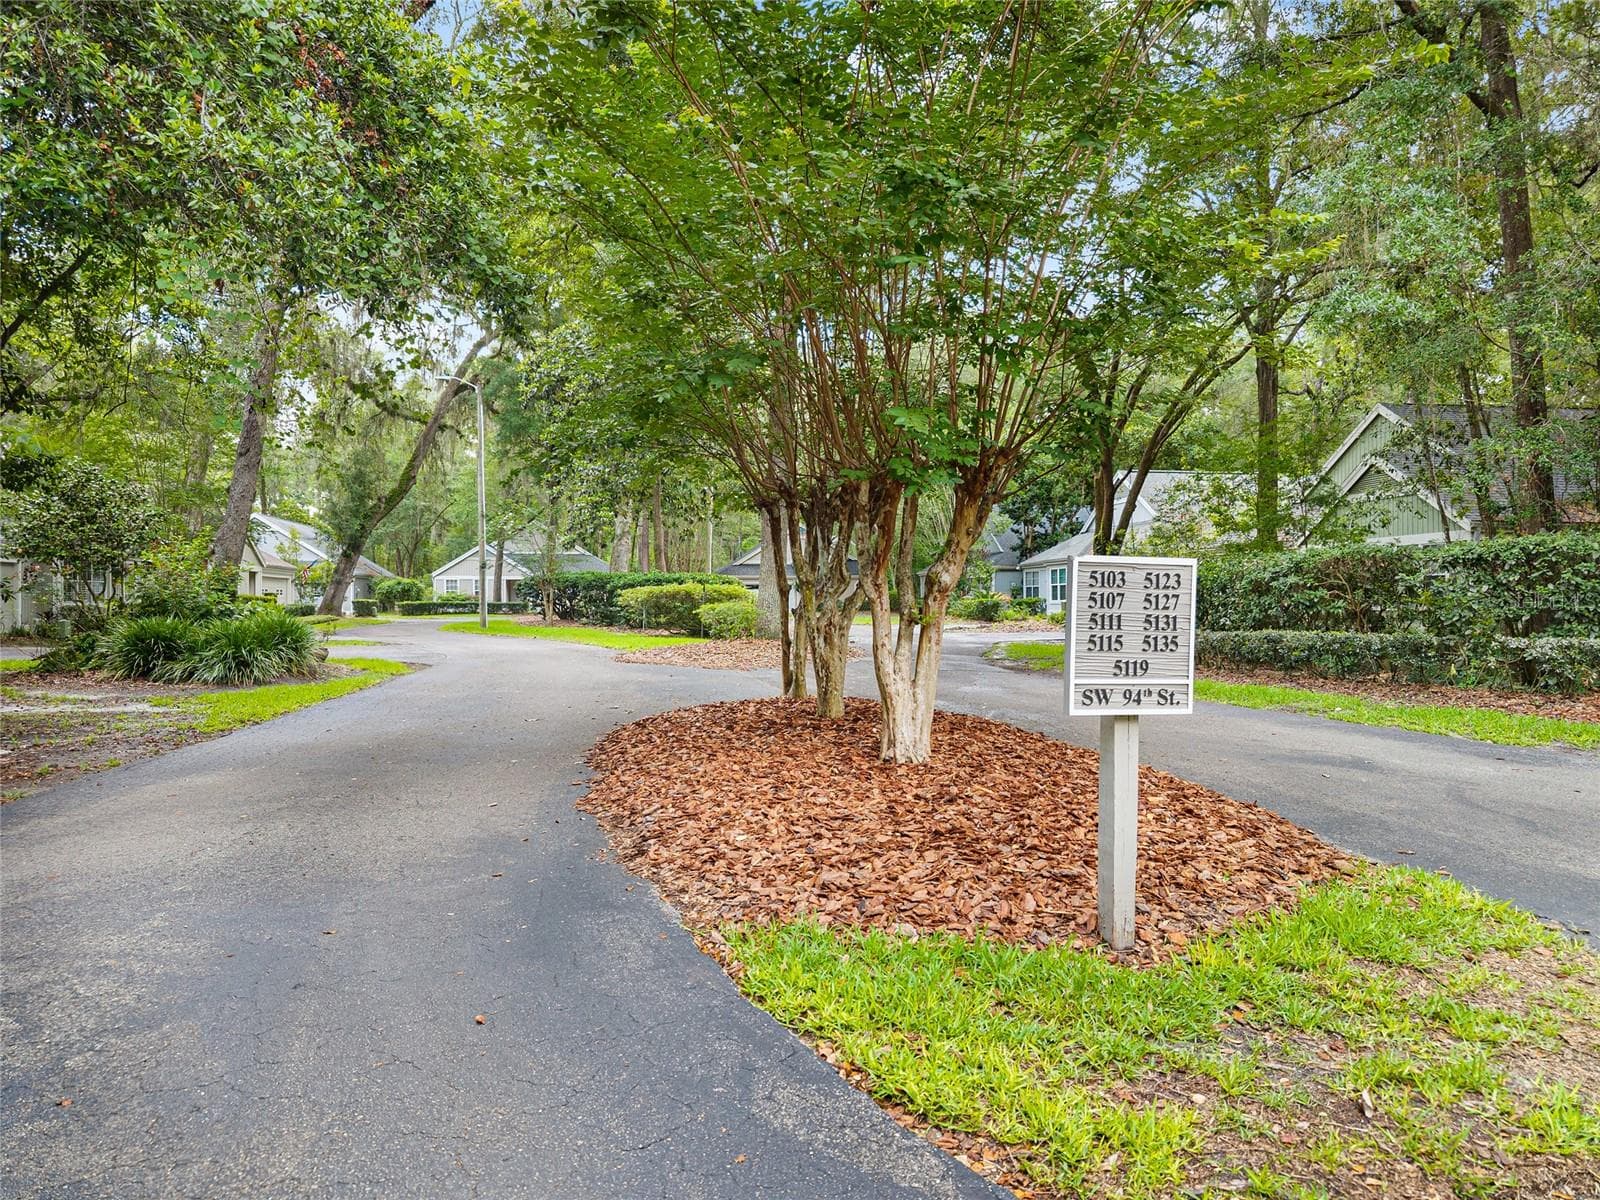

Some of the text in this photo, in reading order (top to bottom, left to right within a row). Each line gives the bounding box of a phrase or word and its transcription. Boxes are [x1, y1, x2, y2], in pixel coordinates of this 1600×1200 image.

[1088, 570, 1181, 590] 5103 5123
[1087, 592, 1180, 611] 5107 5127
[1088, 613, 1178, 631] 5111 5131
[1087, 634, 1179, 652] 5115 5135
[1112, 659, 1149, 677] 5119
[1081, 687, 1180, 706] SW 94th St.
